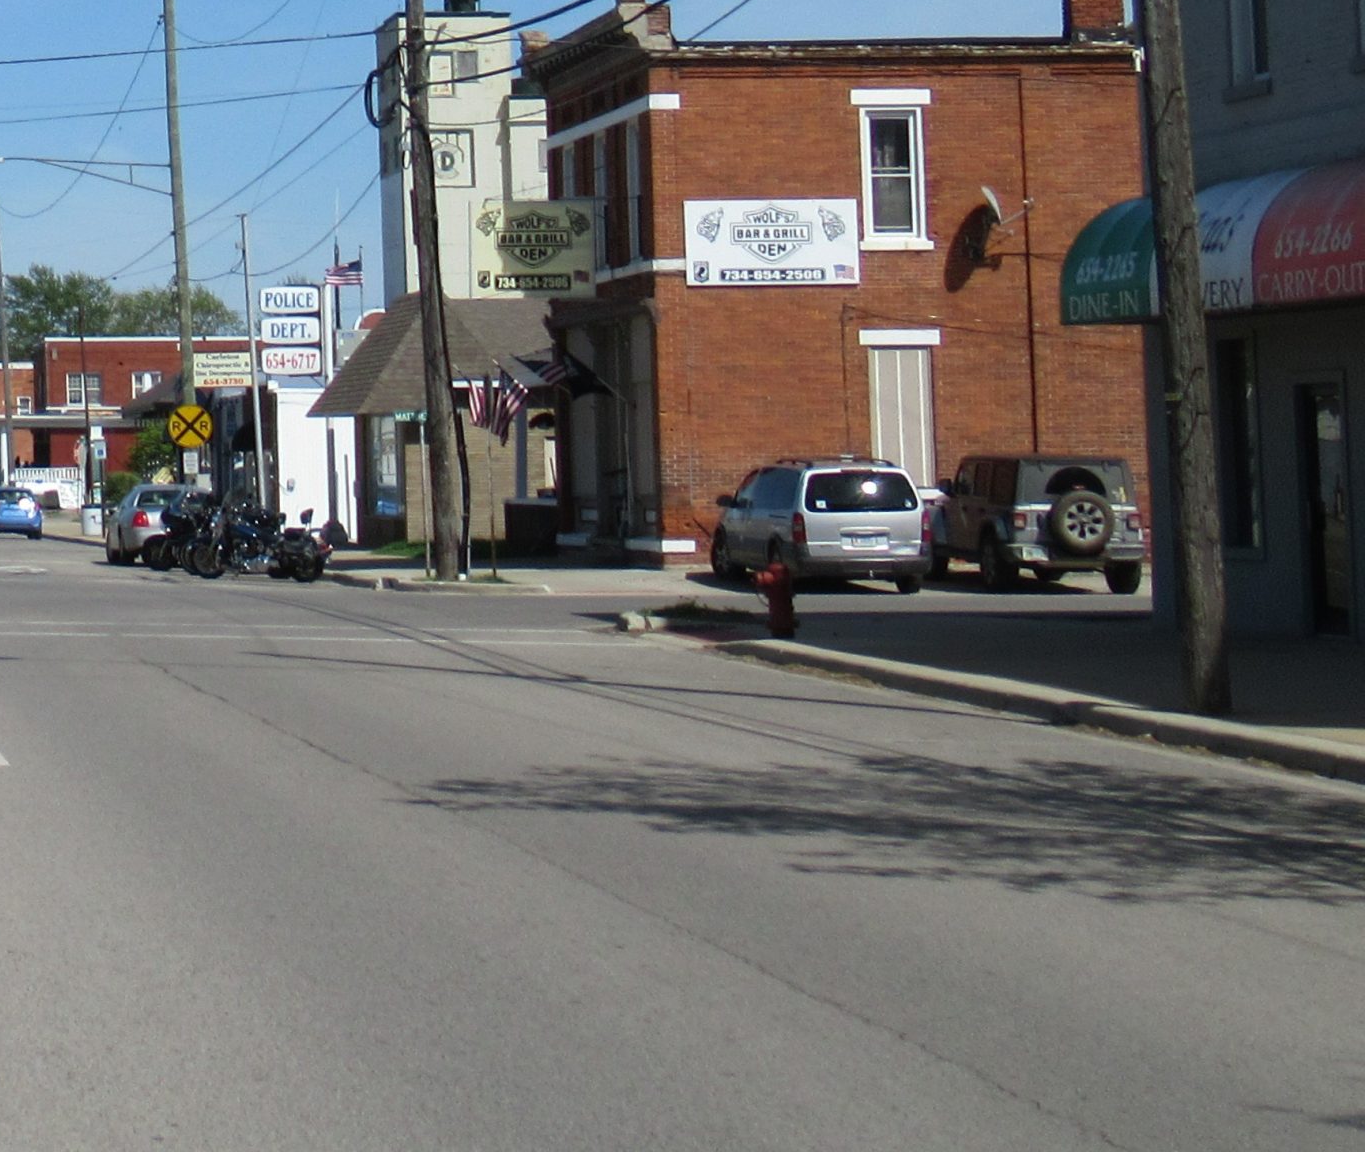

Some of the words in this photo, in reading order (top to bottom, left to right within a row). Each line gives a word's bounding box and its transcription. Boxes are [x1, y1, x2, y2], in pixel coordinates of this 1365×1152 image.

[500, 234, 522, 244] BAR
[525, 234, 532, 244] &
[535, 233, 566, 243] GRILL
[736, 229, 761, 239] BAR
[763, 229, 770, 239] &
[773, 228, 806, 239] GRILL
[519, 248, 548, 261] DEN
[757, 243, 787, 256] DEN
[723, 269, 822, 281] 734-654-2506
[265, 292, 313, 308] POLICE
[1069, 290, 1141, 322] DINE-IN
[271, 323, 311, 338] DEPT.
[266, 353, 316, 369] 654-6717
[173, 421, 181, 432] R
[200, 421, 208, 431] R
